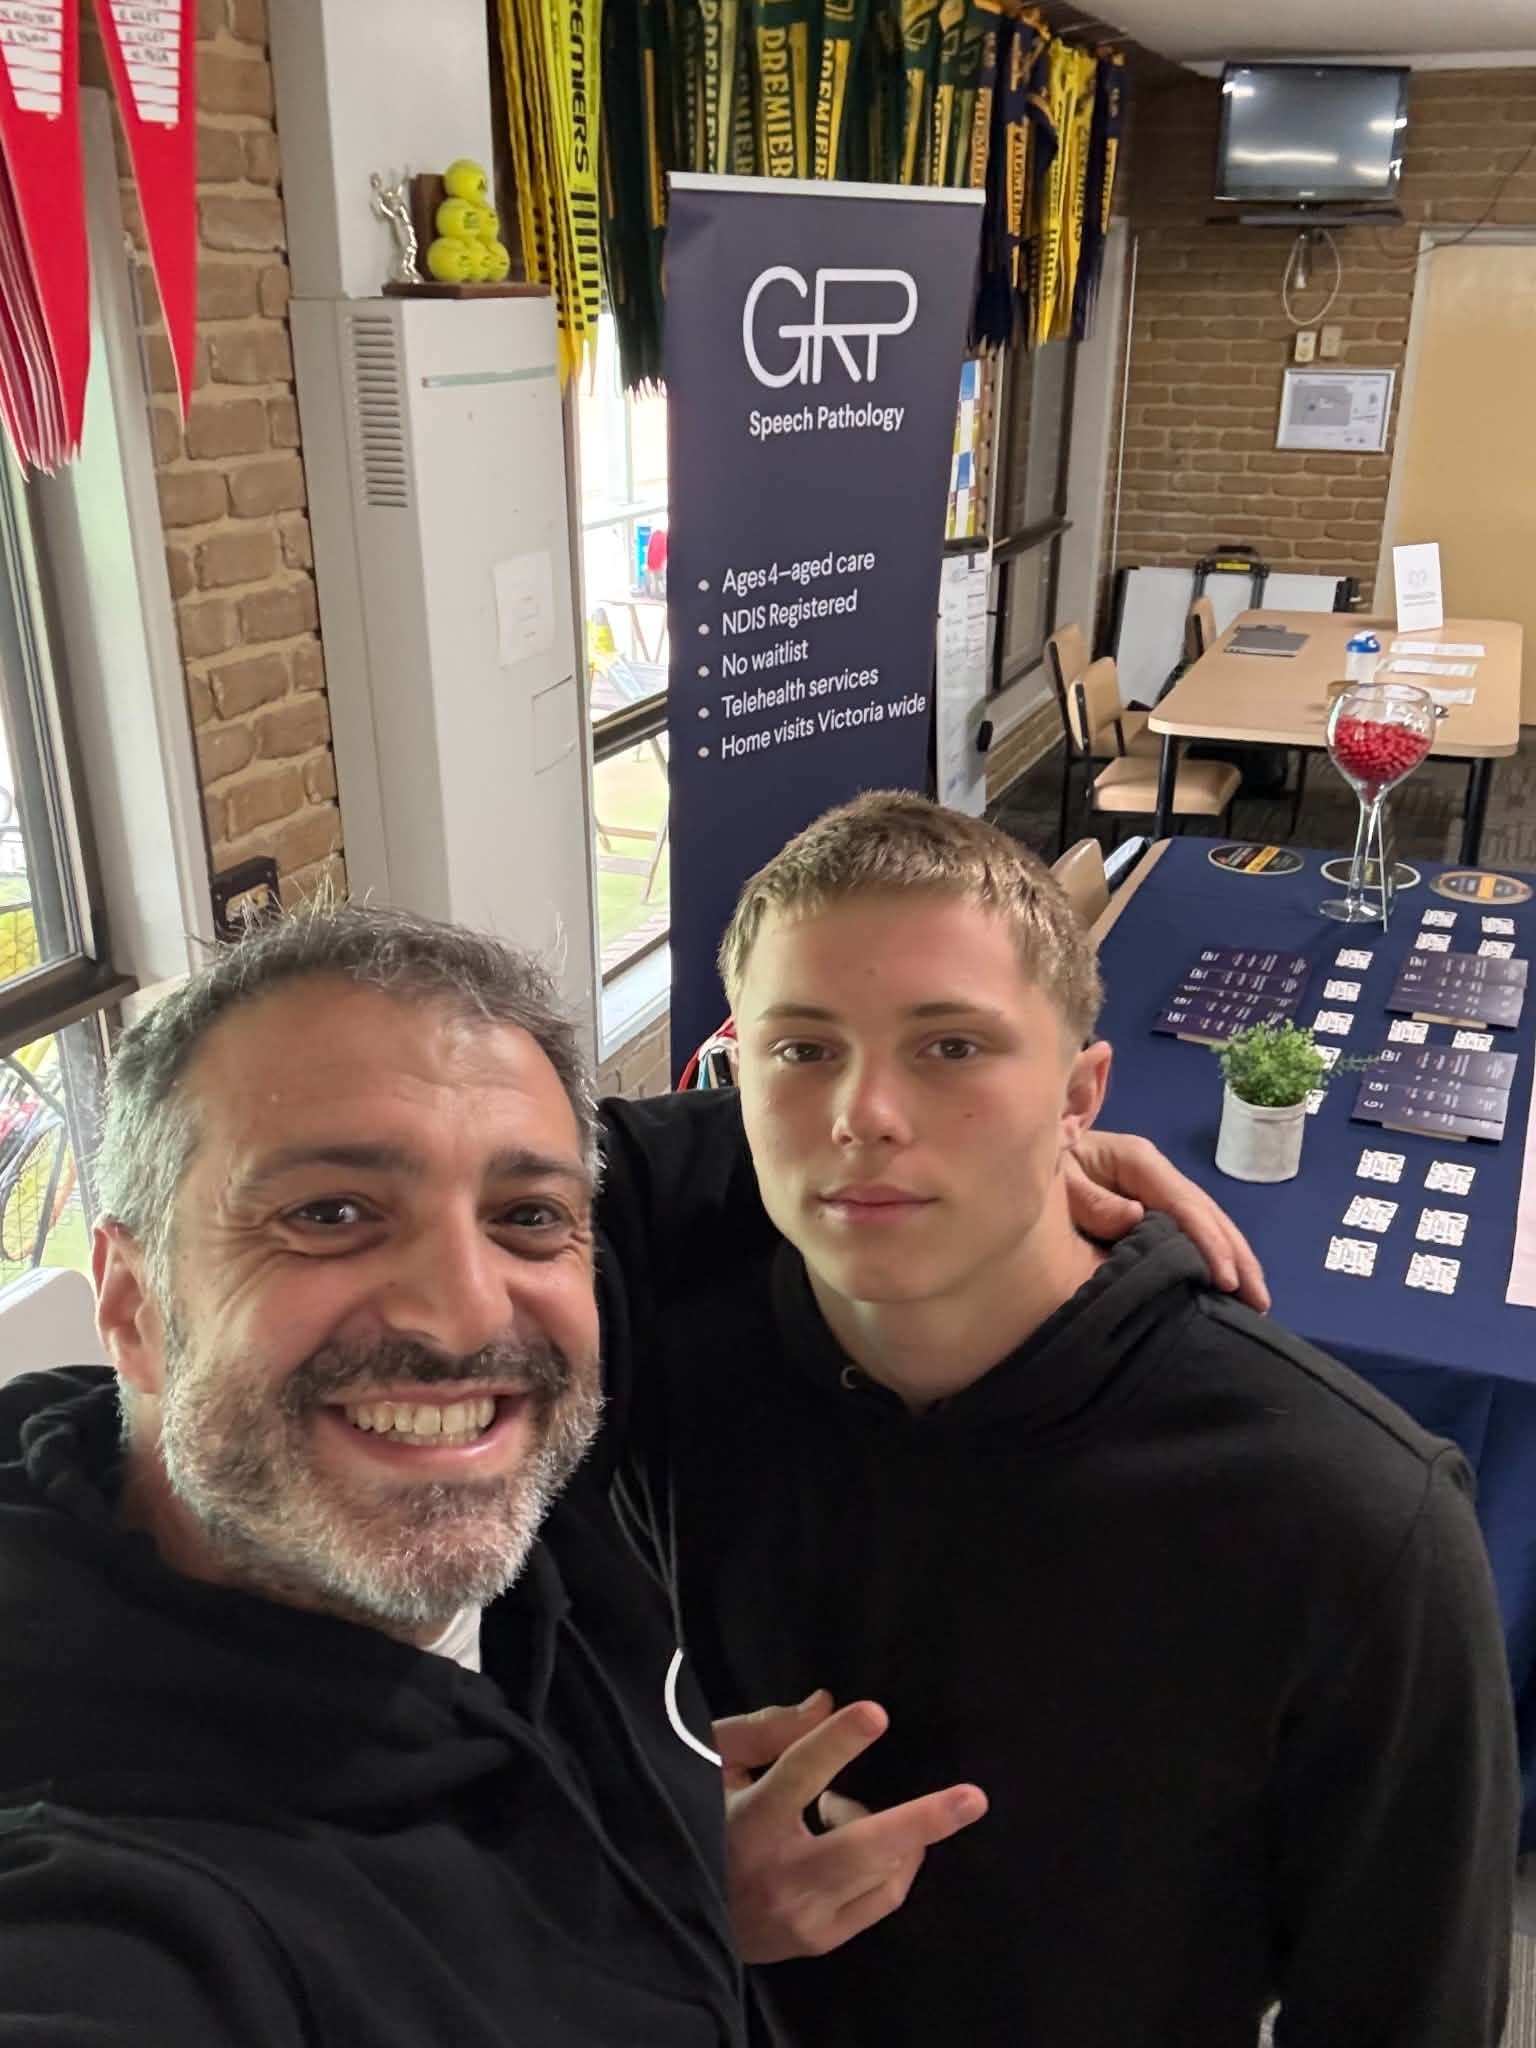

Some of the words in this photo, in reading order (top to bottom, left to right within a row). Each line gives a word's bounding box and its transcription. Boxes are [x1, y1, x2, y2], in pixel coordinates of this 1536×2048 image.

[743, 266, 918, 388] GRP
[750, 406, 813, 441] Speech
[818, 402, 905, 432] Pathology
[722, 568, 766, 597] Ages
[836, 552, 875, 573] care
[722, 606, 766, 636] NDIS
[769, 588, 858, 628] Registered
[722, 653, 748, 678] No
[751, 640, 808, 671] waitlist
[721, 678, 806, 719] Telehealth
[809, 668, 879, 697] services
[721, 730, 771, 760] Home
[774, 716, 814, 743] visits
[818, 701, 883, 732] Victoria
[887, 693, 927, 718] wide
